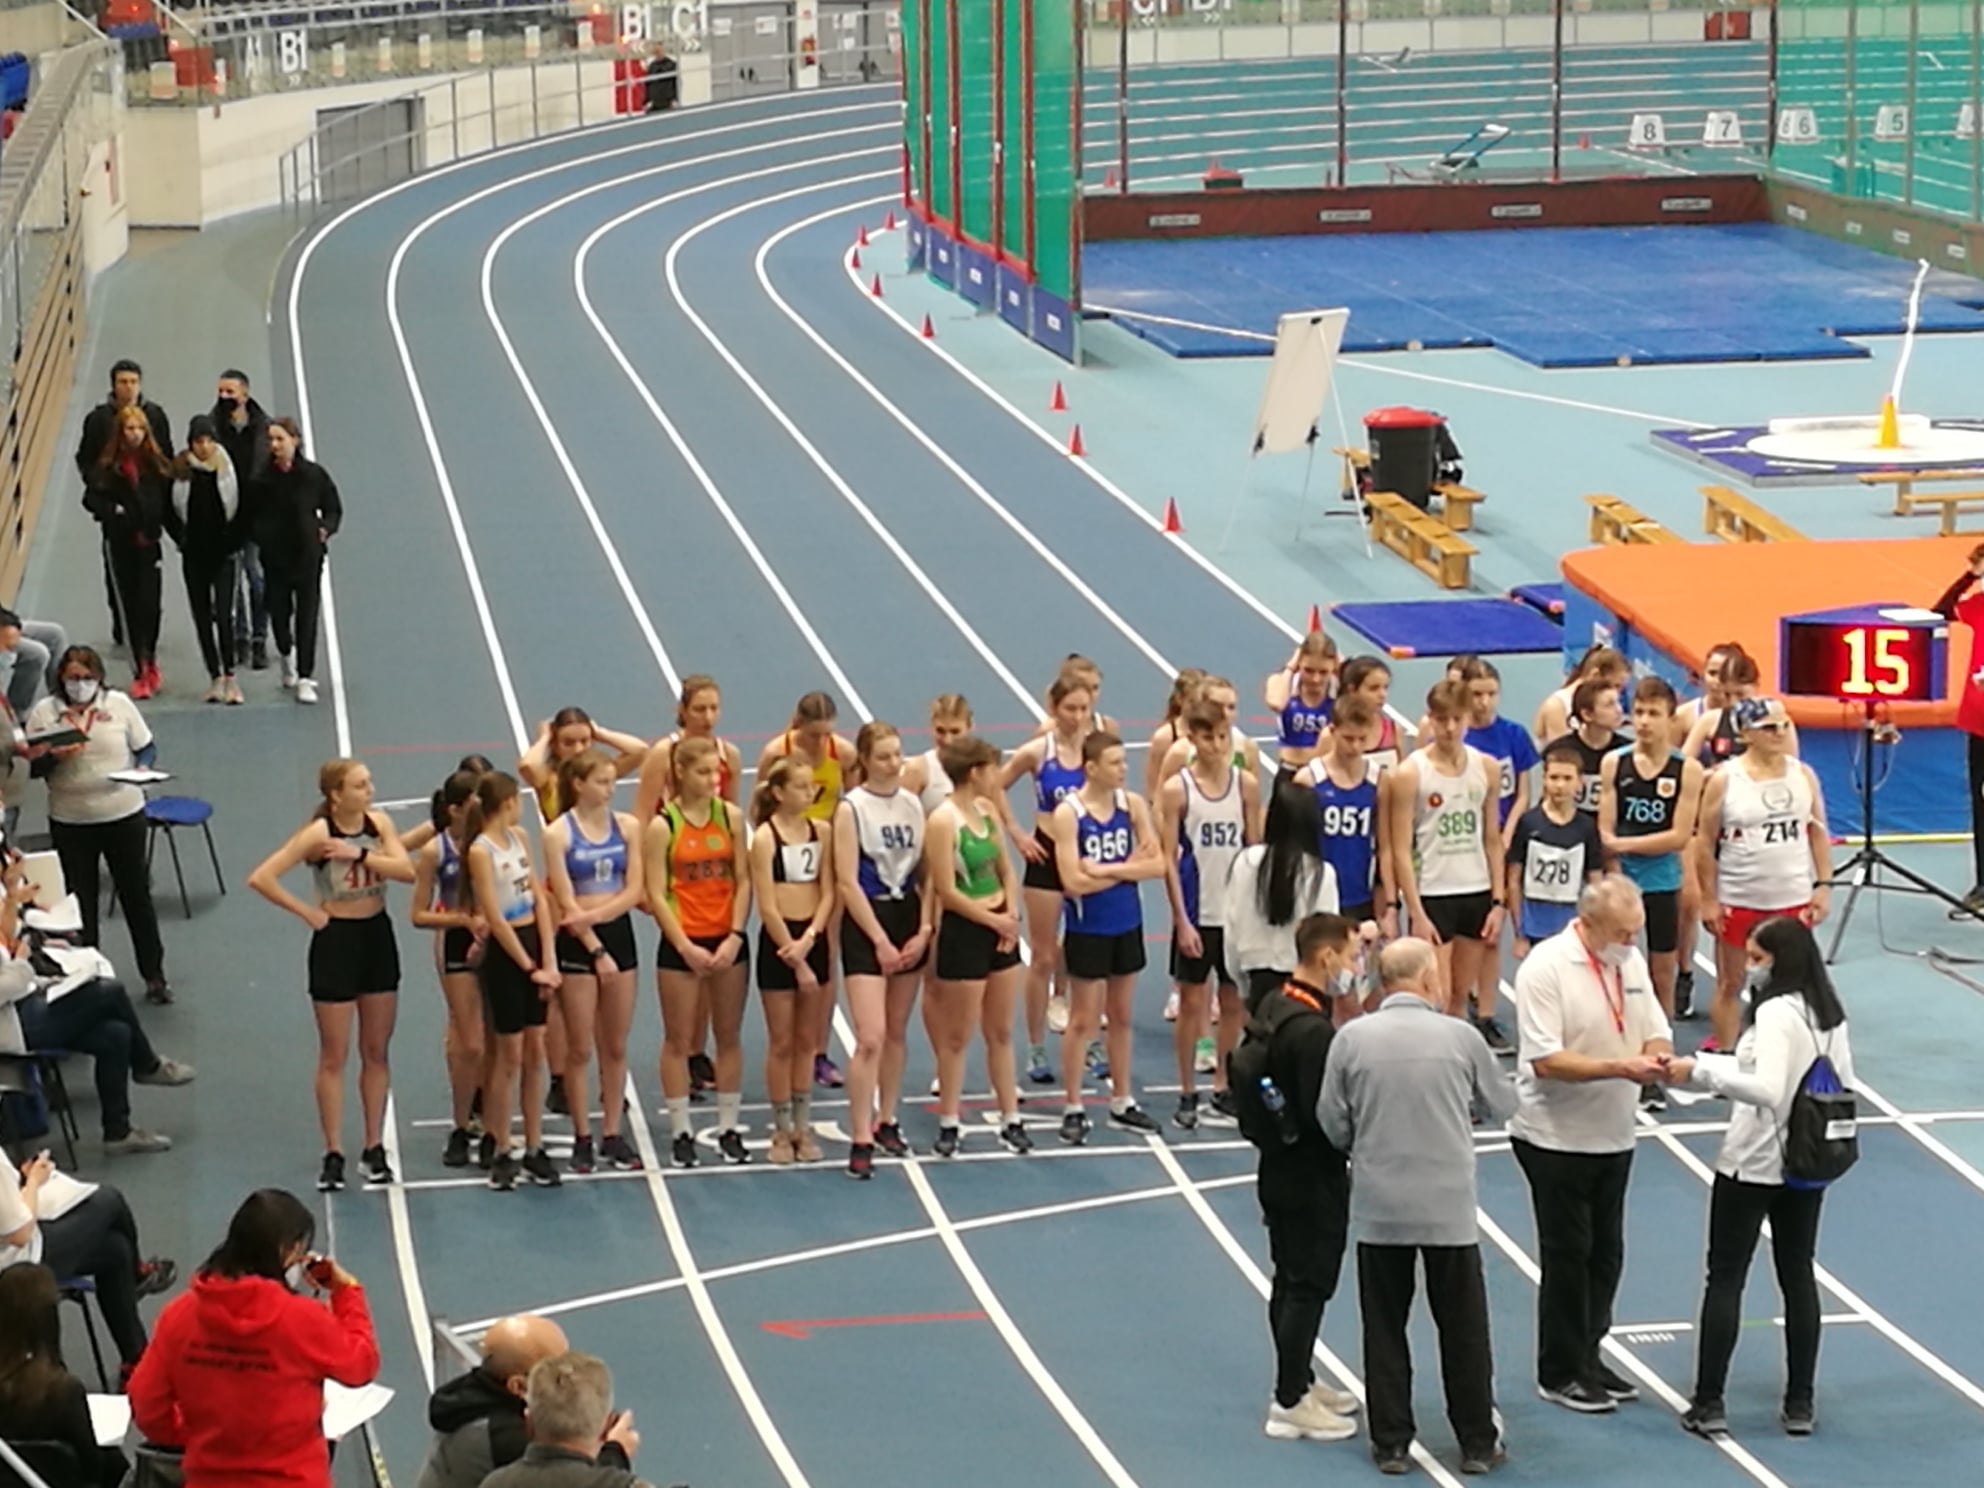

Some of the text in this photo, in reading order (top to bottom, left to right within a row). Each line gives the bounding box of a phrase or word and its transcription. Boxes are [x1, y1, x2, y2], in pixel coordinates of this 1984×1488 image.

[623, 3, 651, 40] B1
[672, 1, 707, 39] C1
[281, 30, 307, 73] B1
[1643, 122, 1657, 142] 8
[1720, 119, 1732, 138] 7
[1798, 116, 1811, 135] 6
[1891, 112, 1904, 132] 5
[1841, 628, 1910, 695] 15
[1323, 805, 1371, 837] 951
[1438, 809, 1477, 837] 389
[1624, 797, 1666, 823] 768
[1201, 822, 1238, 847] 952
[1761, 818, 1800, 844] 214
[1085, 827, 1129, 864] 956
[800, 846, 815, 875] 2
[1533, 858, 1571, 885] 278
